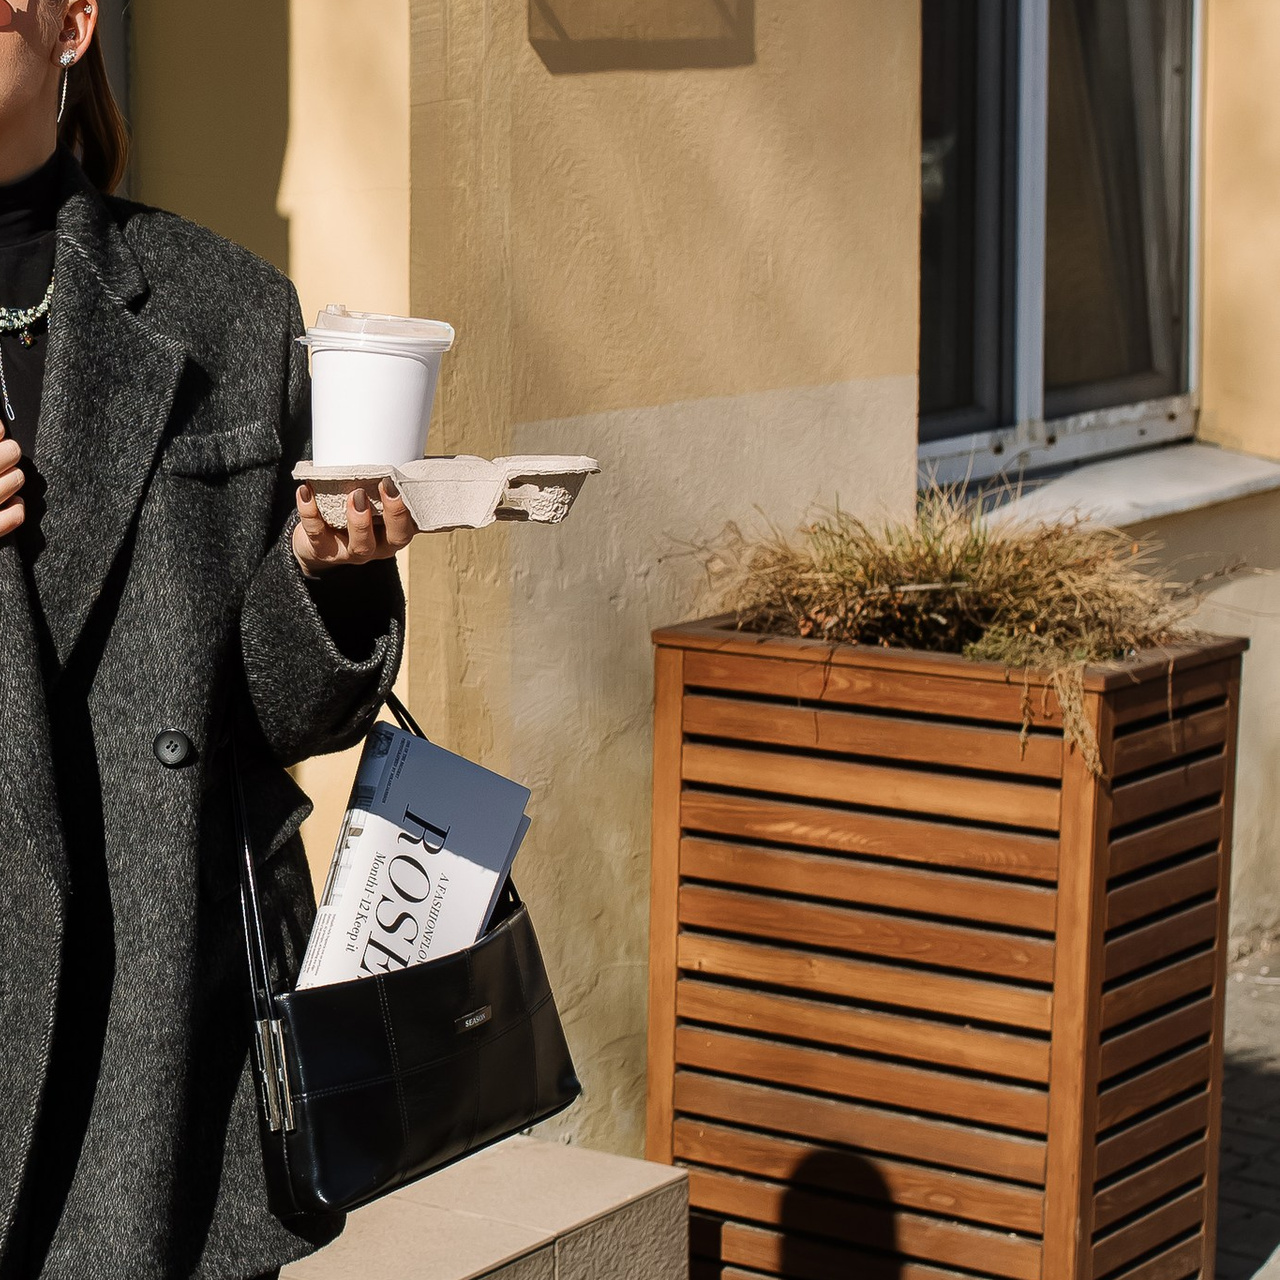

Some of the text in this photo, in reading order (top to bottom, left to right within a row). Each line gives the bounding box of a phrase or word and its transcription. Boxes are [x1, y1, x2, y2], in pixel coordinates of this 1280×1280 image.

[357, 803, 451, 979] ROSE
[417, 873, 450, 964] A FASHIONFLO
[345, 943, 359, 952] it
[346, 912, 368, 941] Keep
